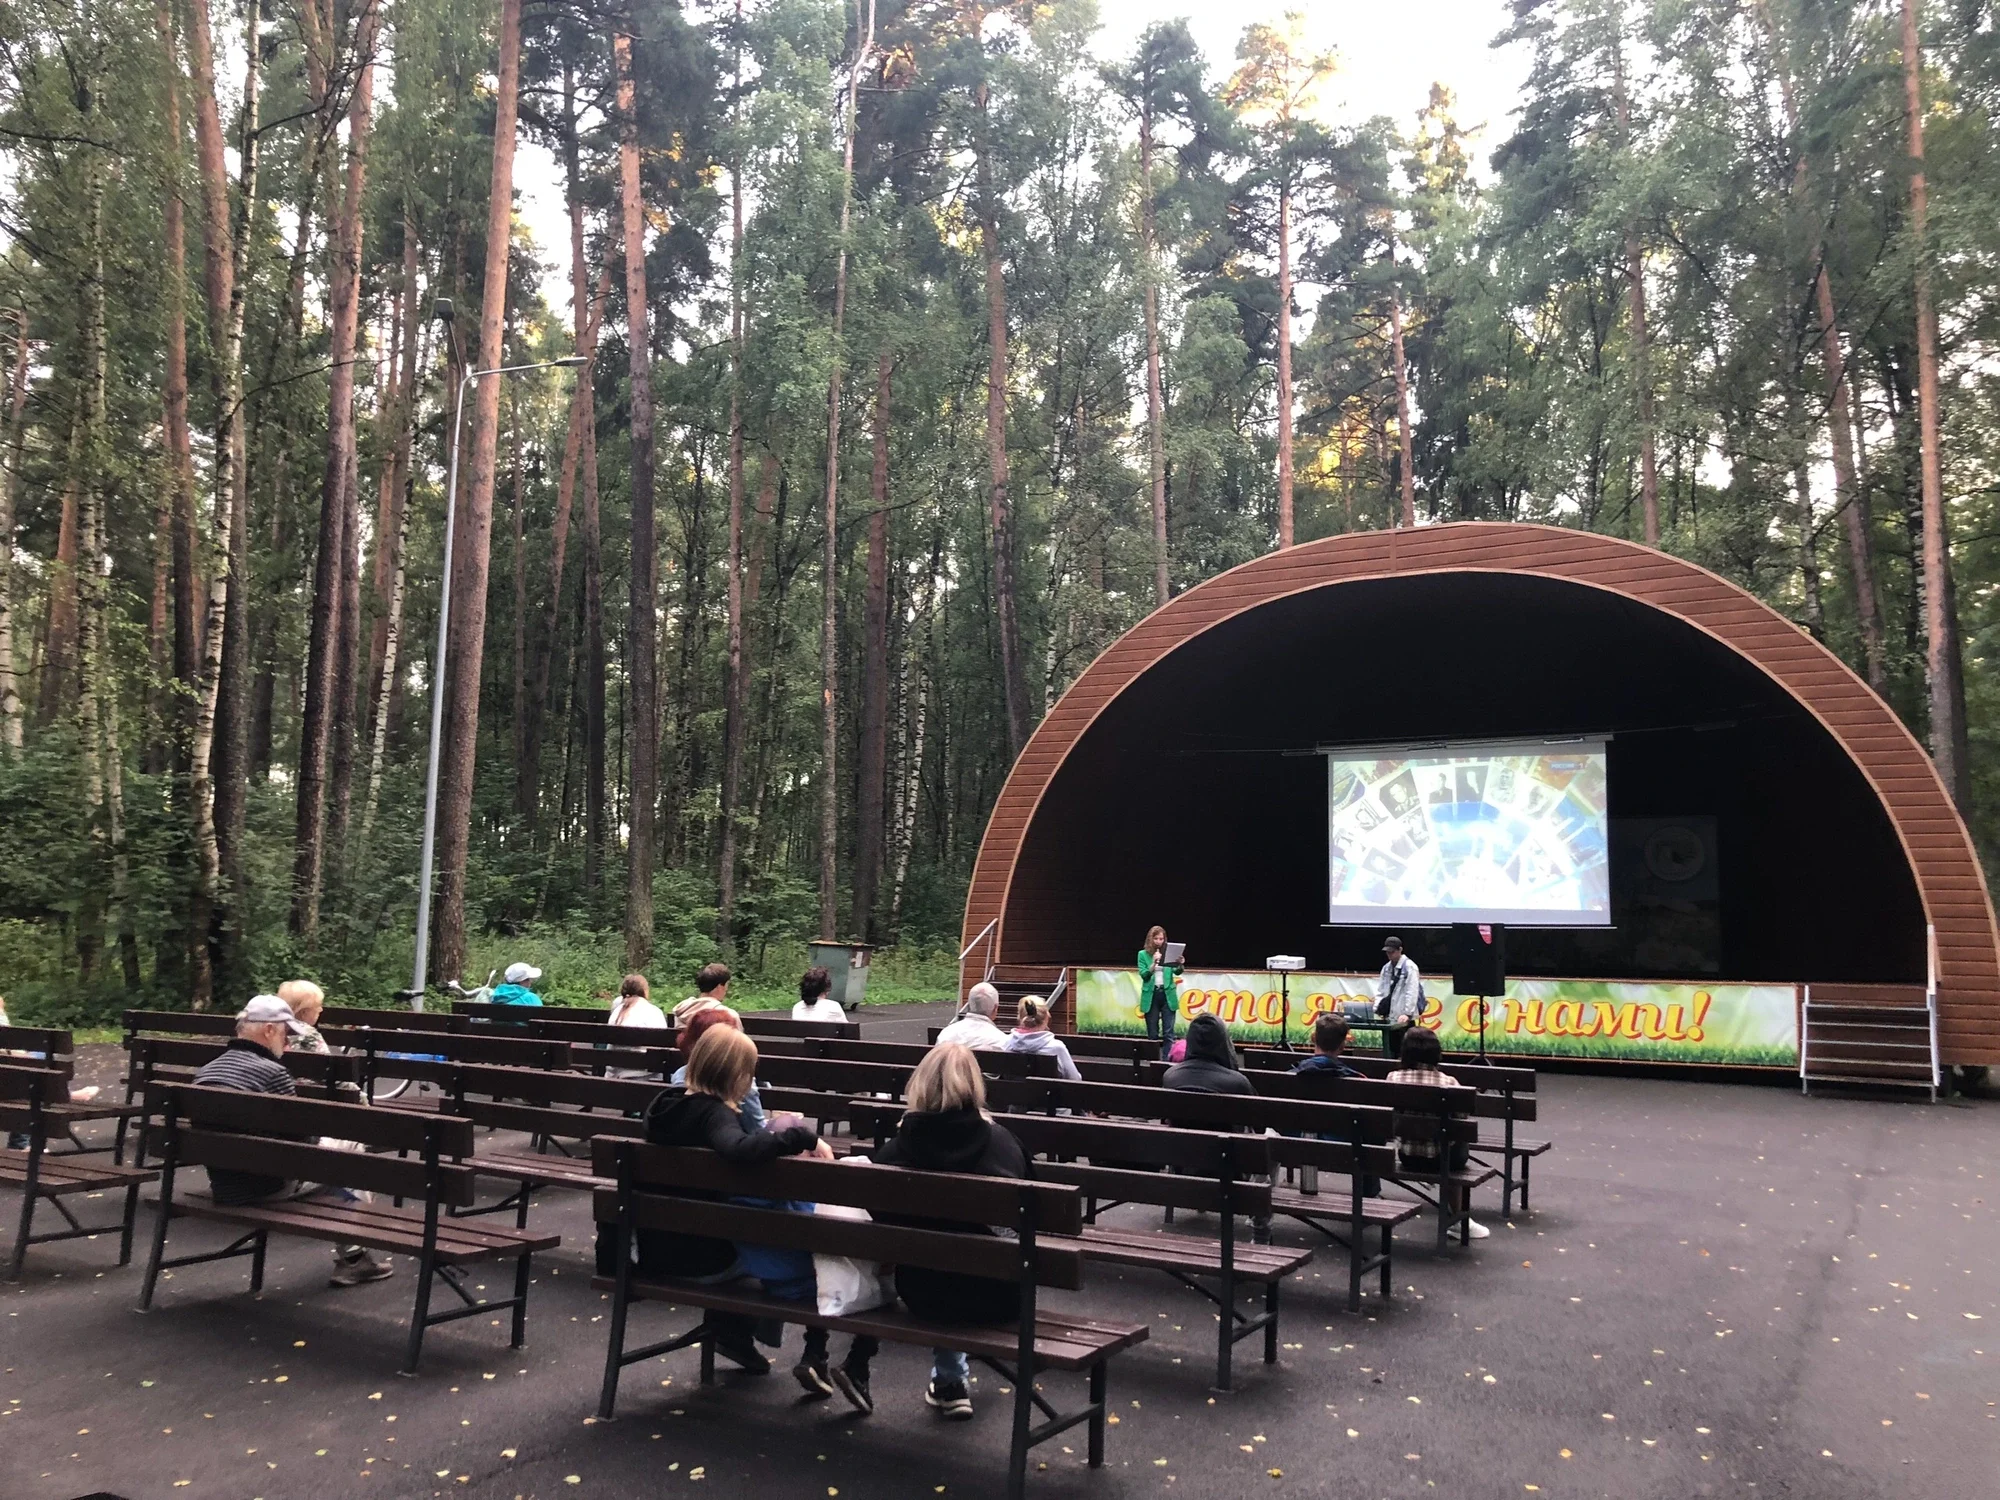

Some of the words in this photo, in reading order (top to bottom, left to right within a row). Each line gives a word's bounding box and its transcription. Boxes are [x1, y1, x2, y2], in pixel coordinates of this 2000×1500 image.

[1135, 976, 1290, 1024] ето
[1301, 992, 1443, 1041] яе
[1456, 997, 1490, 1033] с
[1503, 990, 1712, 1042] нами!
